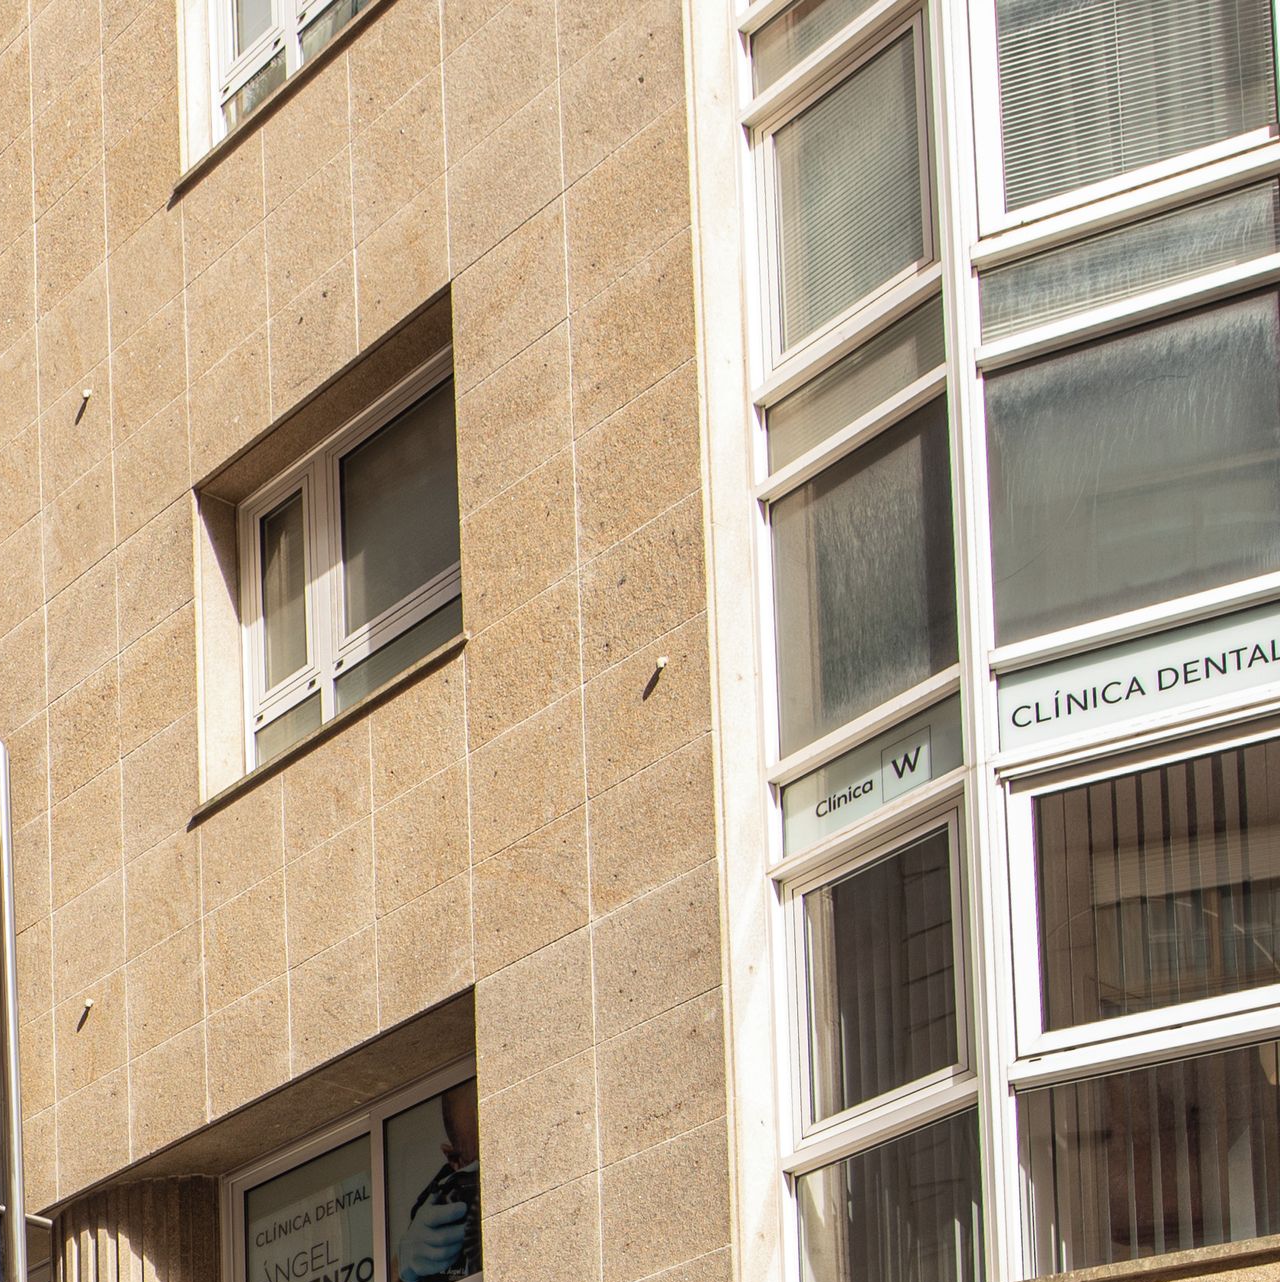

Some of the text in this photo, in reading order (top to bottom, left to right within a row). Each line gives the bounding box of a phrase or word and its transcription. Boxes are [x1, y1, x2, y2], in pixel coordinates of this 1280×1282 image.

[1012, 639, 1280, 728] CLÍNICA DENTAL
[816, 746, 922, 818] Clínica W
[256, 1186, 371, 1248] CLÍNICA DENTAL
